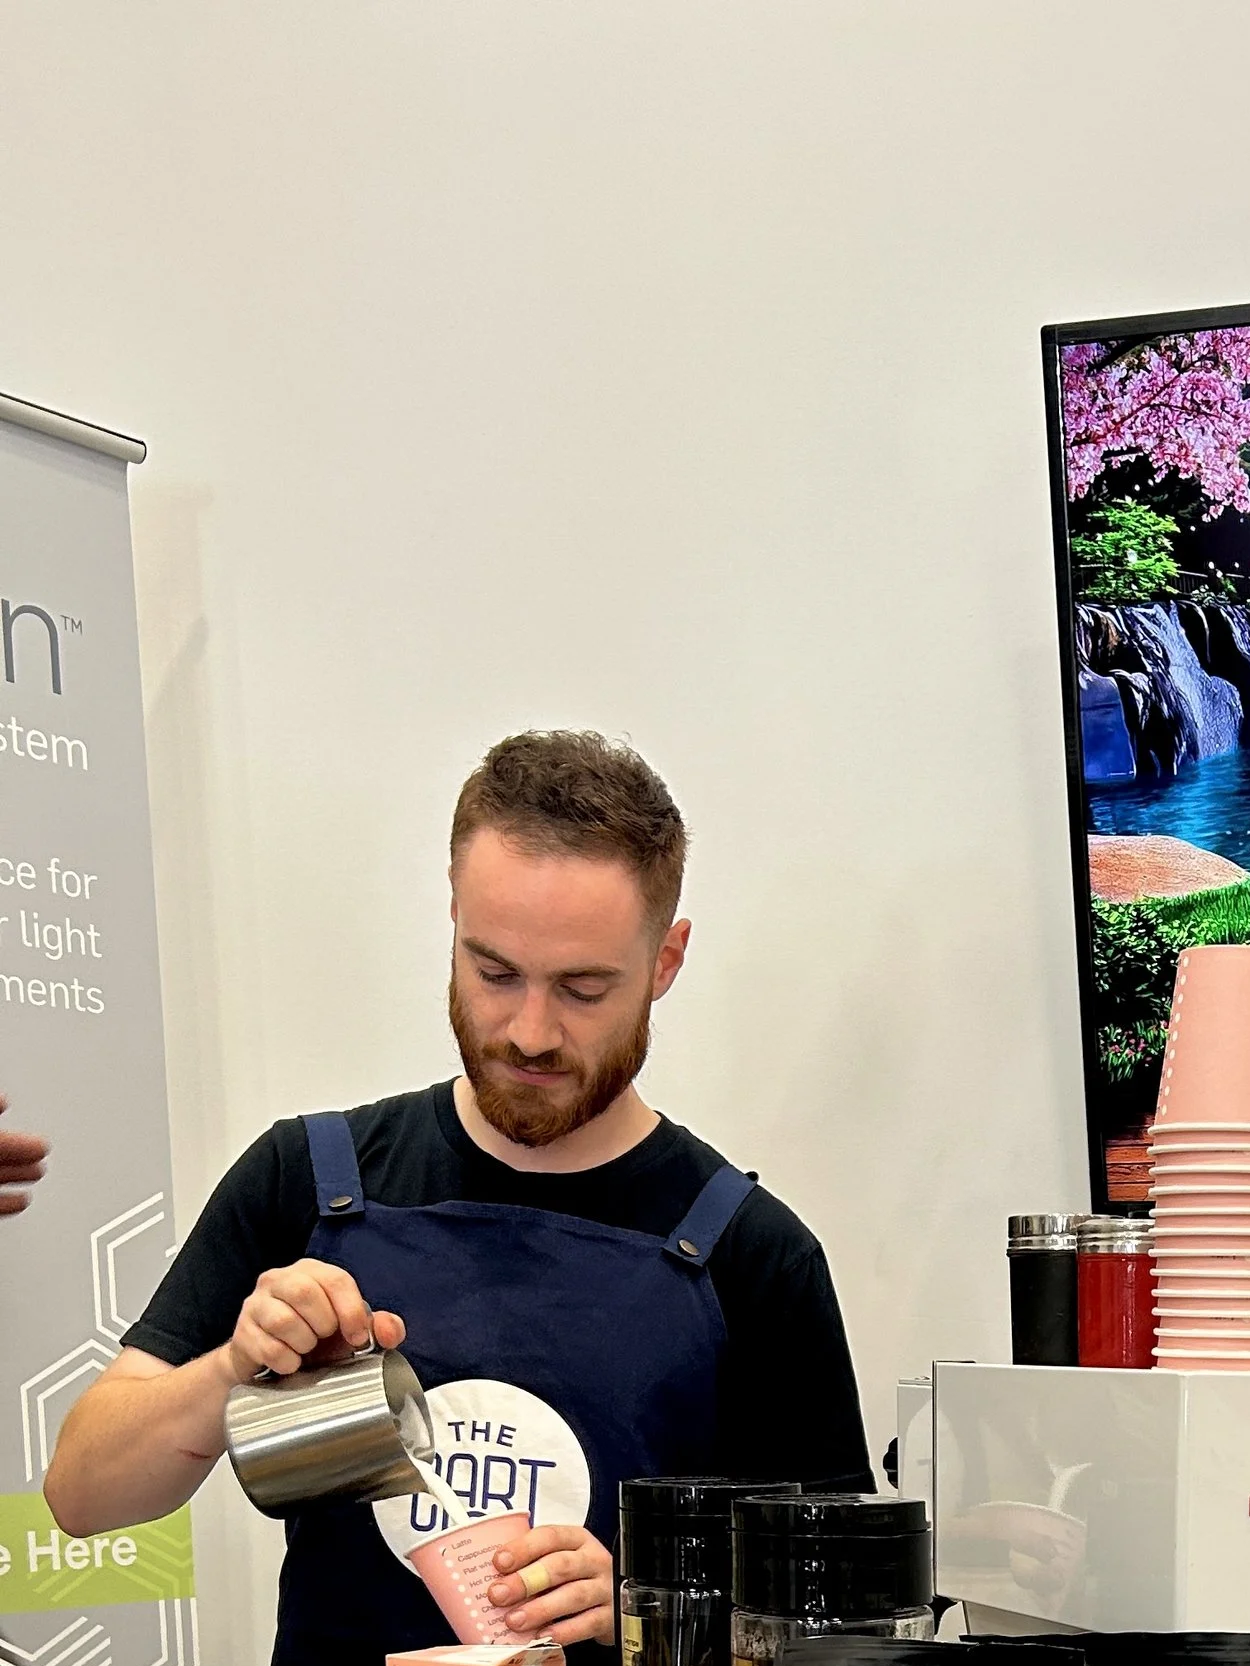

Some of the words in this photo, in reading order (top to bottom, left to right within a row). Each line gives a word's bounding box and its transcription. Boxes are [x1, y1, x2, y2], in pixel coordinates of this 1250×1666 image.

[46, 857, 98, 900] for
[20, 910, 103, 961] light
[447, 1420, 517, 1448] THE
[27, 1529, 138, 1573] Here
